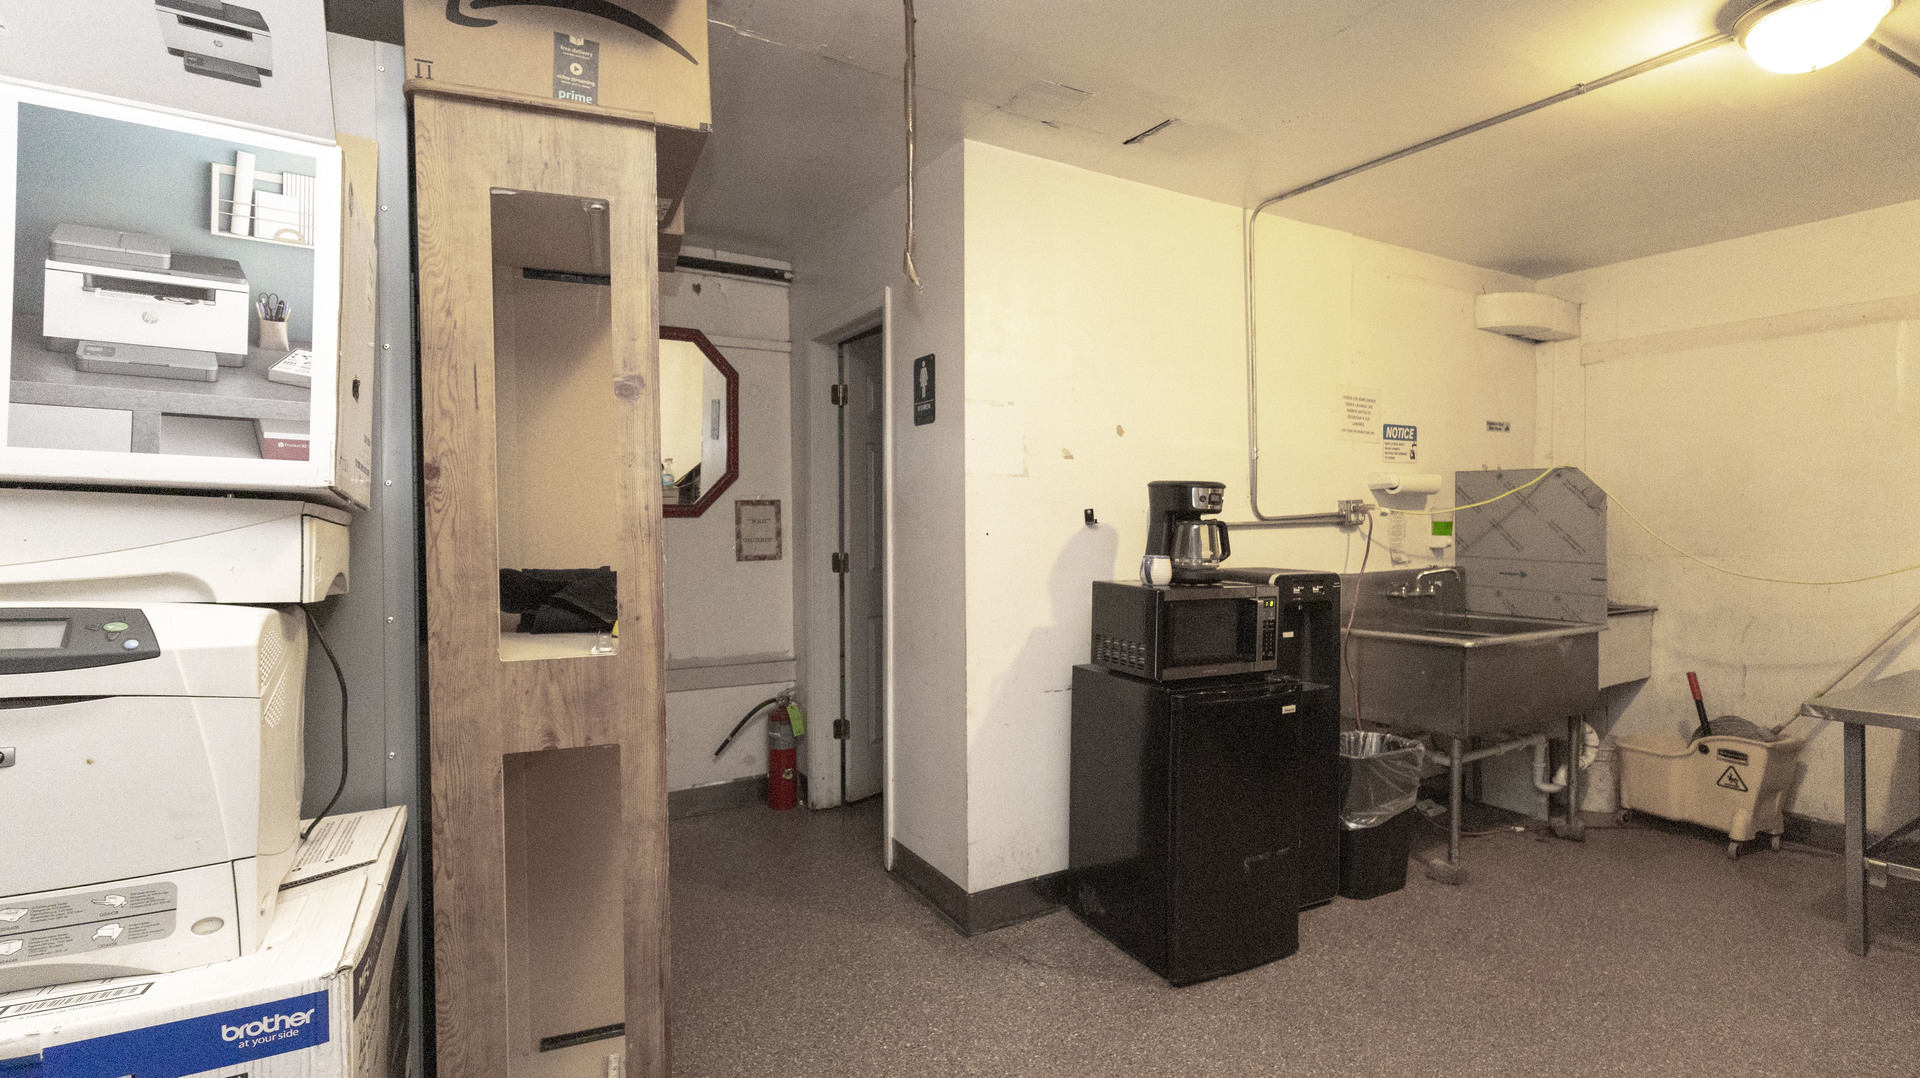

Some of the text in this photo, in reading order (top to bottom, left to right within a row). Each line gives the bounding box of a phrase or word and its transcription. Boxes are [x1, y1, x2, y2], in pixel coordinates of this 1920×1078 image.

[558, 90, 593, 104] prime
[1386, 426, 1415, 440] NOTICE
[221, 1008, 315, 1042] brother
[238, 1029, 300, 1049] at your side
